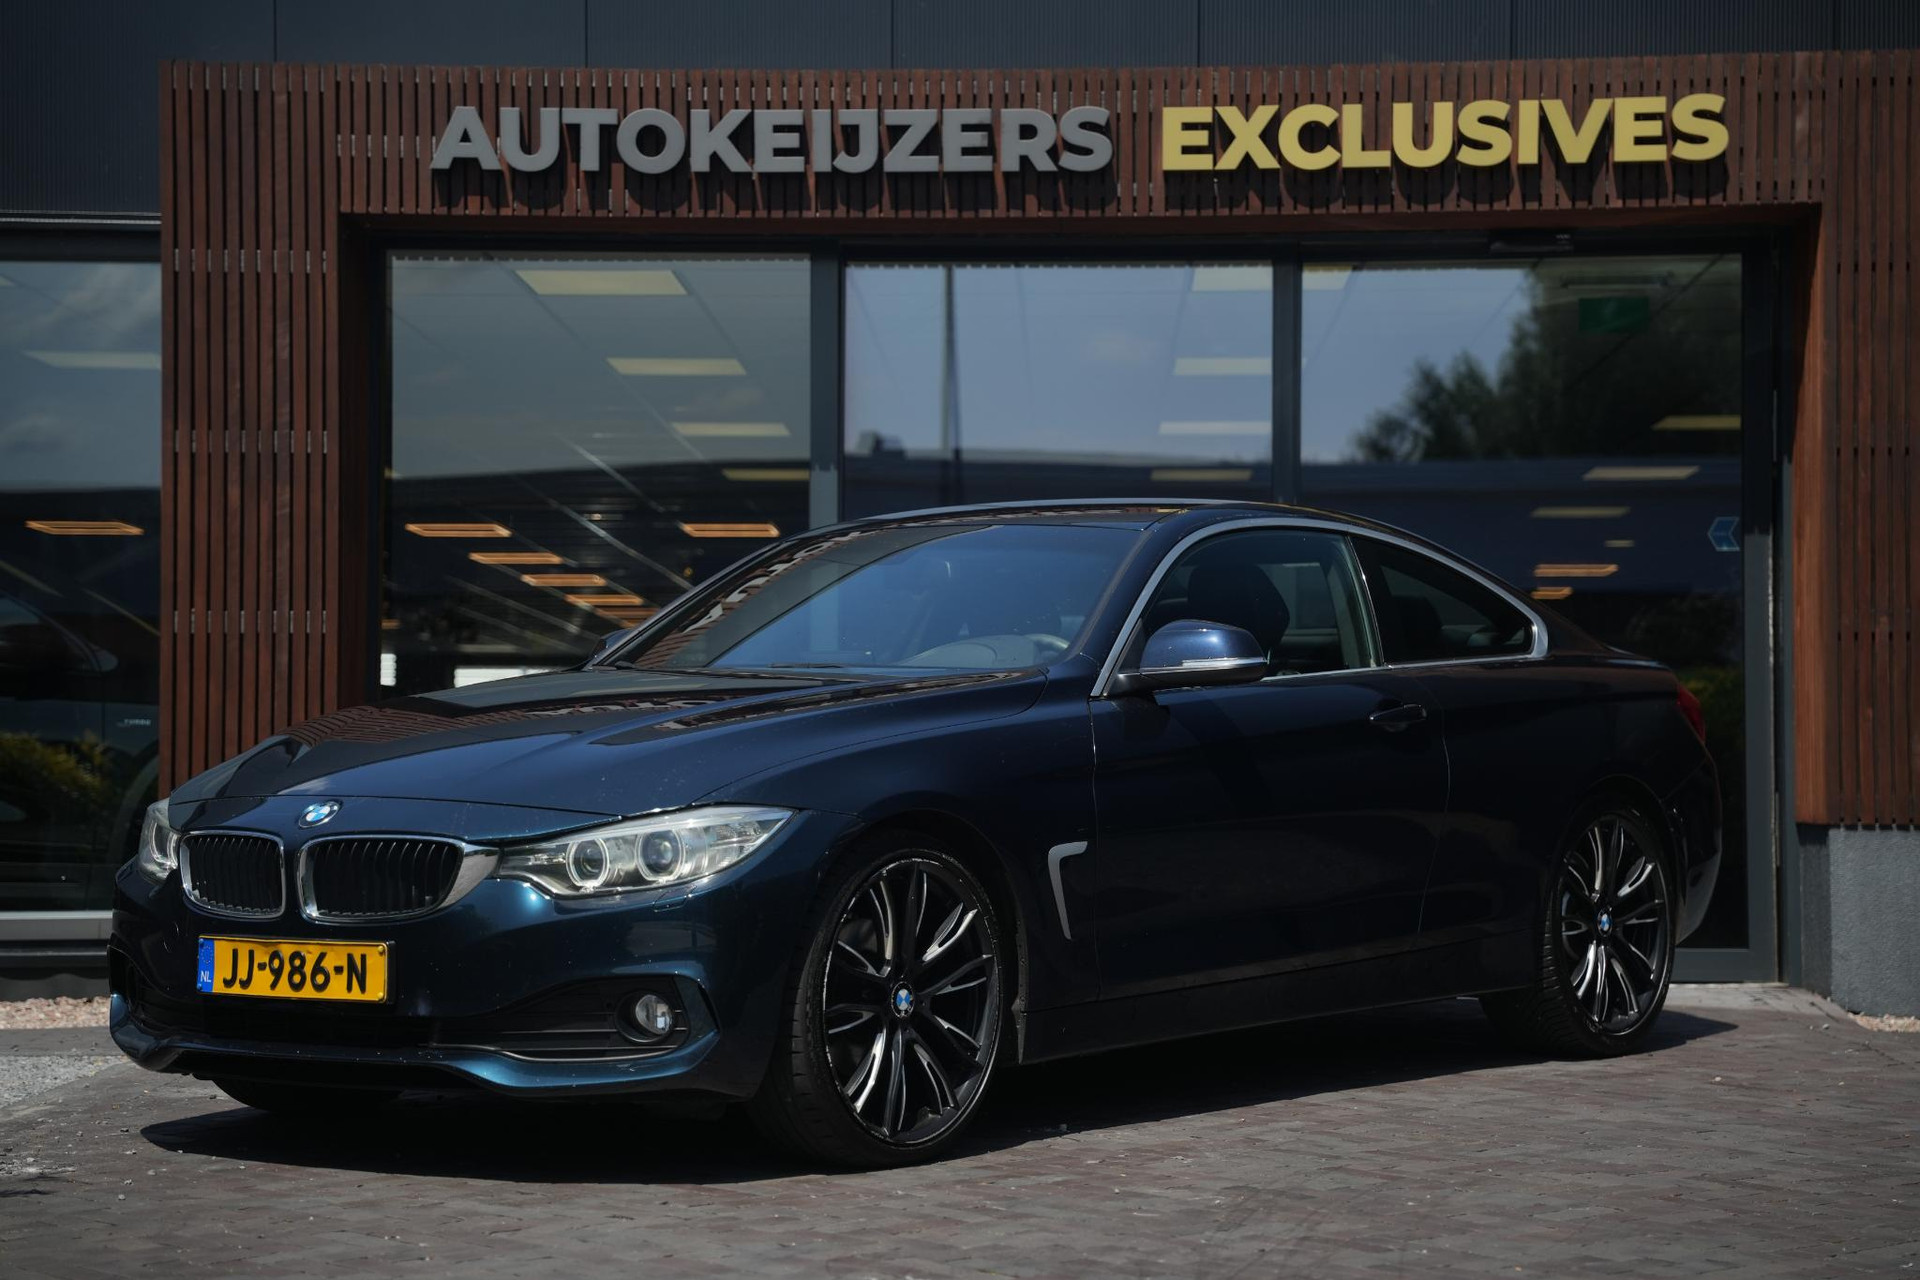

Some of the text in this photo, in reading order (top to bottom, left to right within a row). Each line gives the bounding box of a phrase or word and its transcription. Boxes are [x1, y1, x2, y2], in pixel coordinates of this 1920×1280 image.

[429, 93, 1730, 174] AUTOKEIJZERS EXCLUSIVES
[200, 970, 212, 983] NL
[222, 947, 367, 995] JJ-986-N
